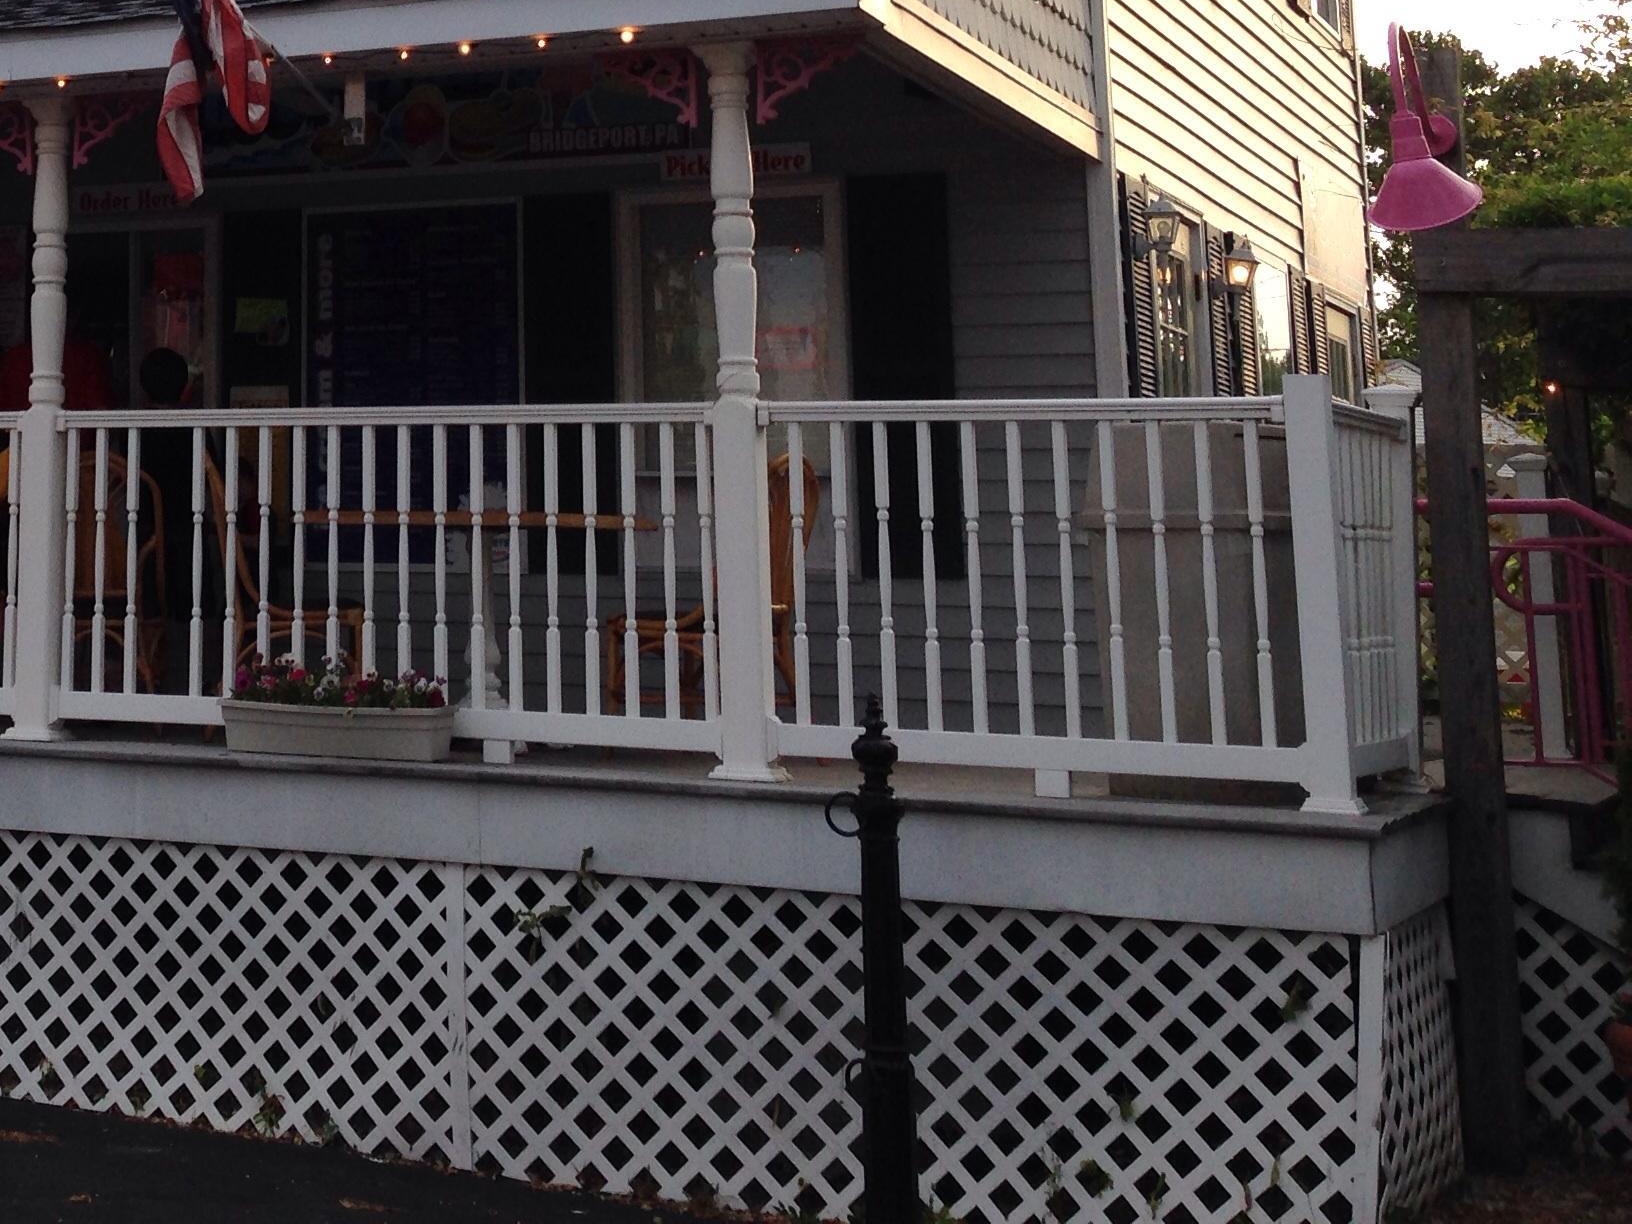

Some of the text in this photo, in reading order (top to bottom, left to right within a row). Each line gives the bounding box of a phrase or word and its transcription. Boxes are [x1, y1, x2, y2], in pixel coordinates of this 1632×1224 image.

[654, 124, 680, 146] PA
[666, 149, 806, 177] Pick Here
[79, 190, 130, 212] Order
